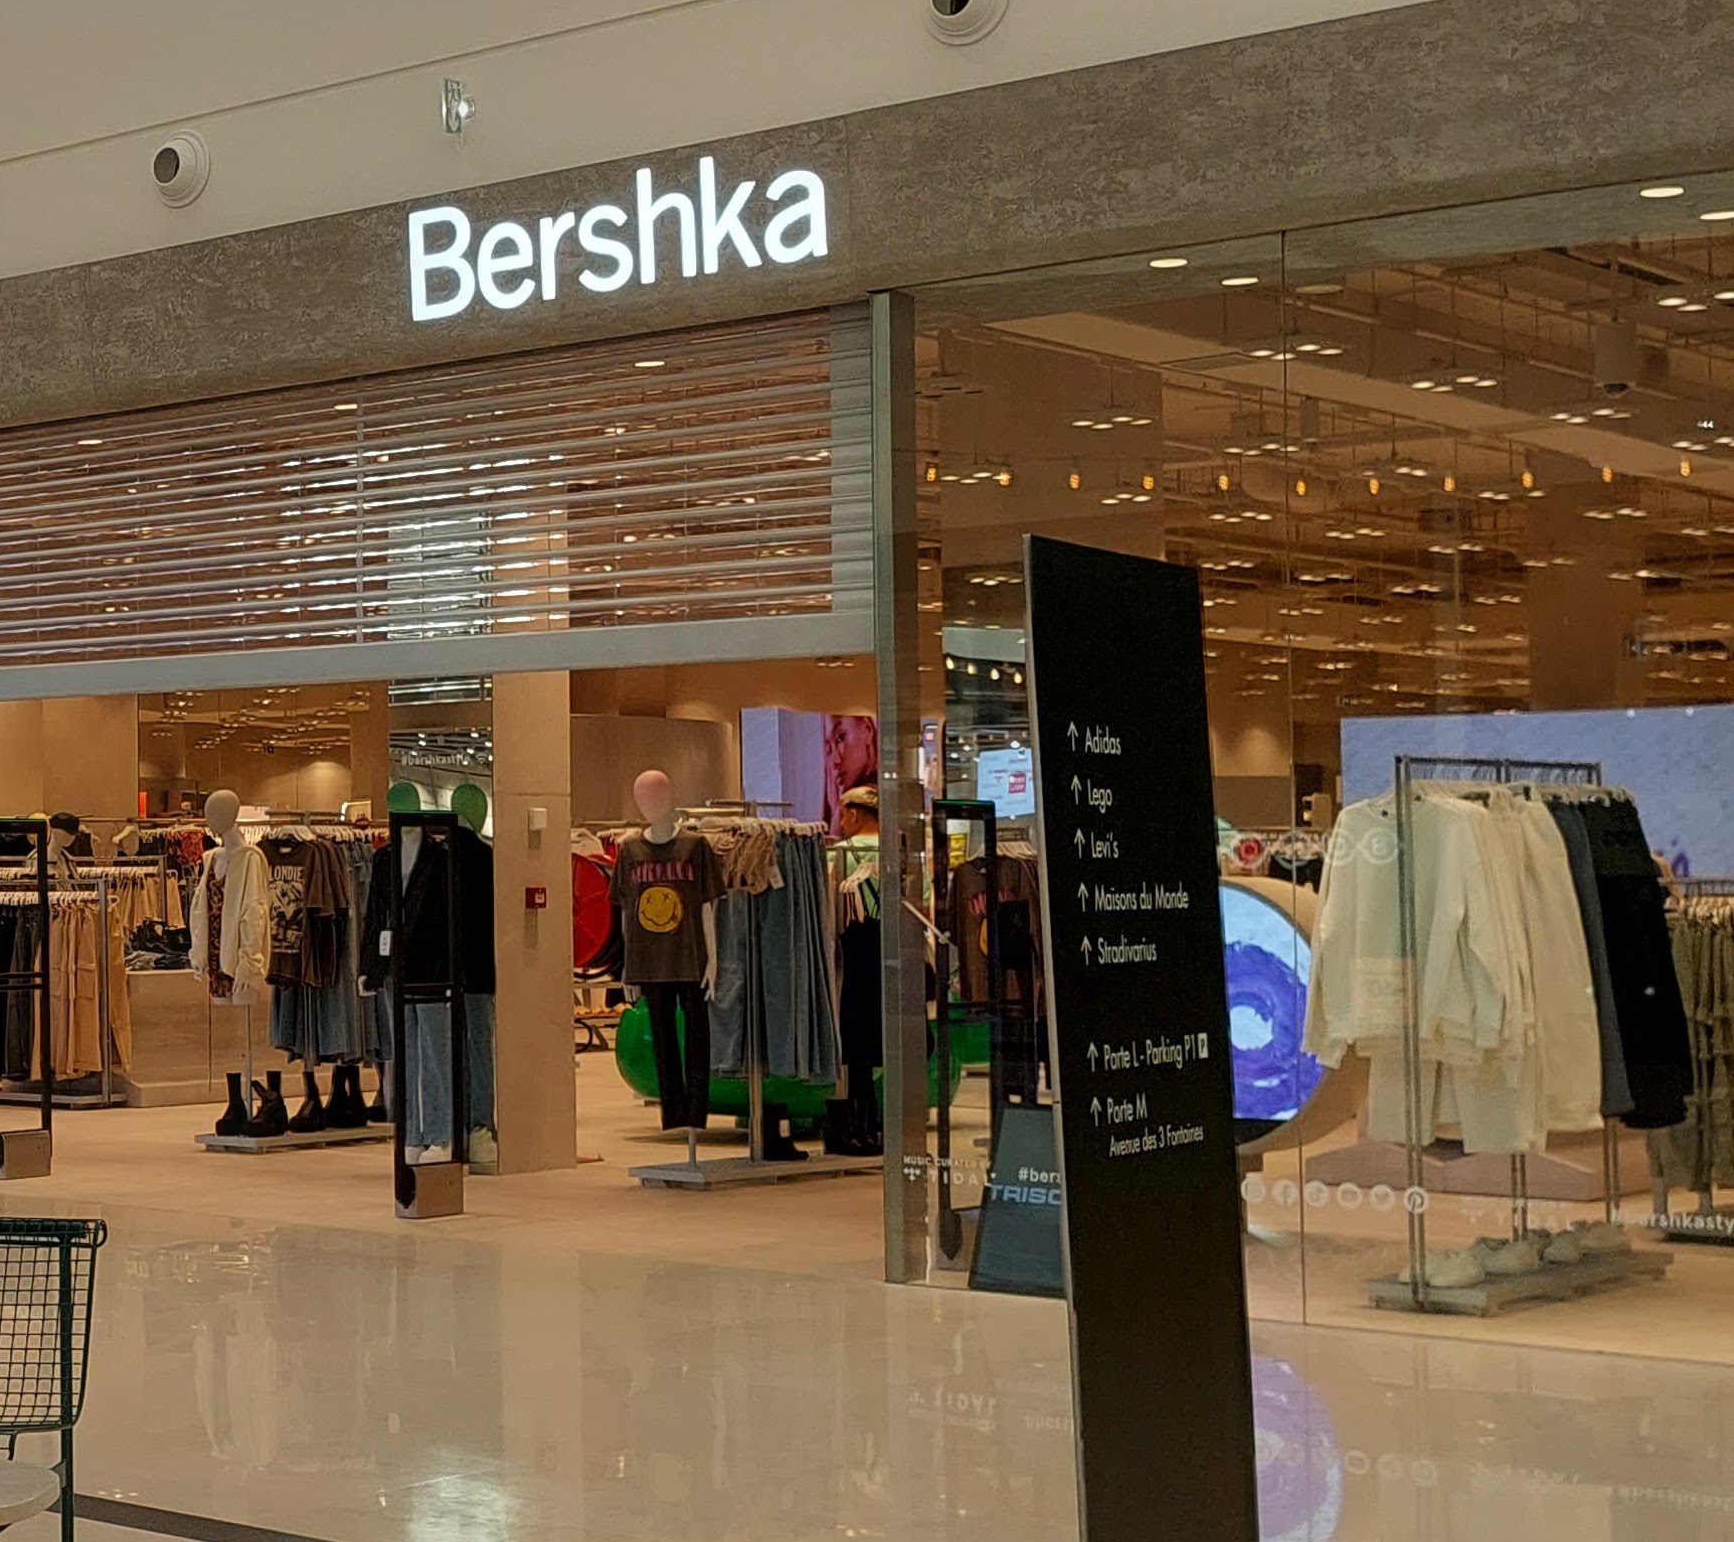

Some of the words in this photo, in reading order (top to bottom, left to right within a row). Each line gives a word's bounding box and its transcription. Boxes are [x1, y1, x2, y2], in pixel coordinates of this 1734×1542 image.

[405, 153, 830, 323] Bershka
[1084, 724, 1121, 755] Adidas
[1087, 779, 1113, 813] Lego
[1091, 831, 1119, 859] Levi's
[267, 866, 305, 881] LONDIE
[1094, 884, 1137, 911] Maisons
[1139, 881, 1152, 910] du
[1154, 881, 1189, 910] Monde
[1097, 934, 1157, 964] Stradivarius
[1103, 1044, 1131, 1071] Porte
[1146, 1036, 1183, 1069] Parking
[1107, 1097, 1134, 1125] Porte
[1136, 1092, 1148, 1120] M
[1109, 1134, 1140, 1157] Avenue
[1142, 1127, 1157, 1151] des
[1158, 1125, 1165, 1148] 3
[1166, 1123, 1204, 1146] Fontaines
[903, 1155, 931, 1165] MUSIC
